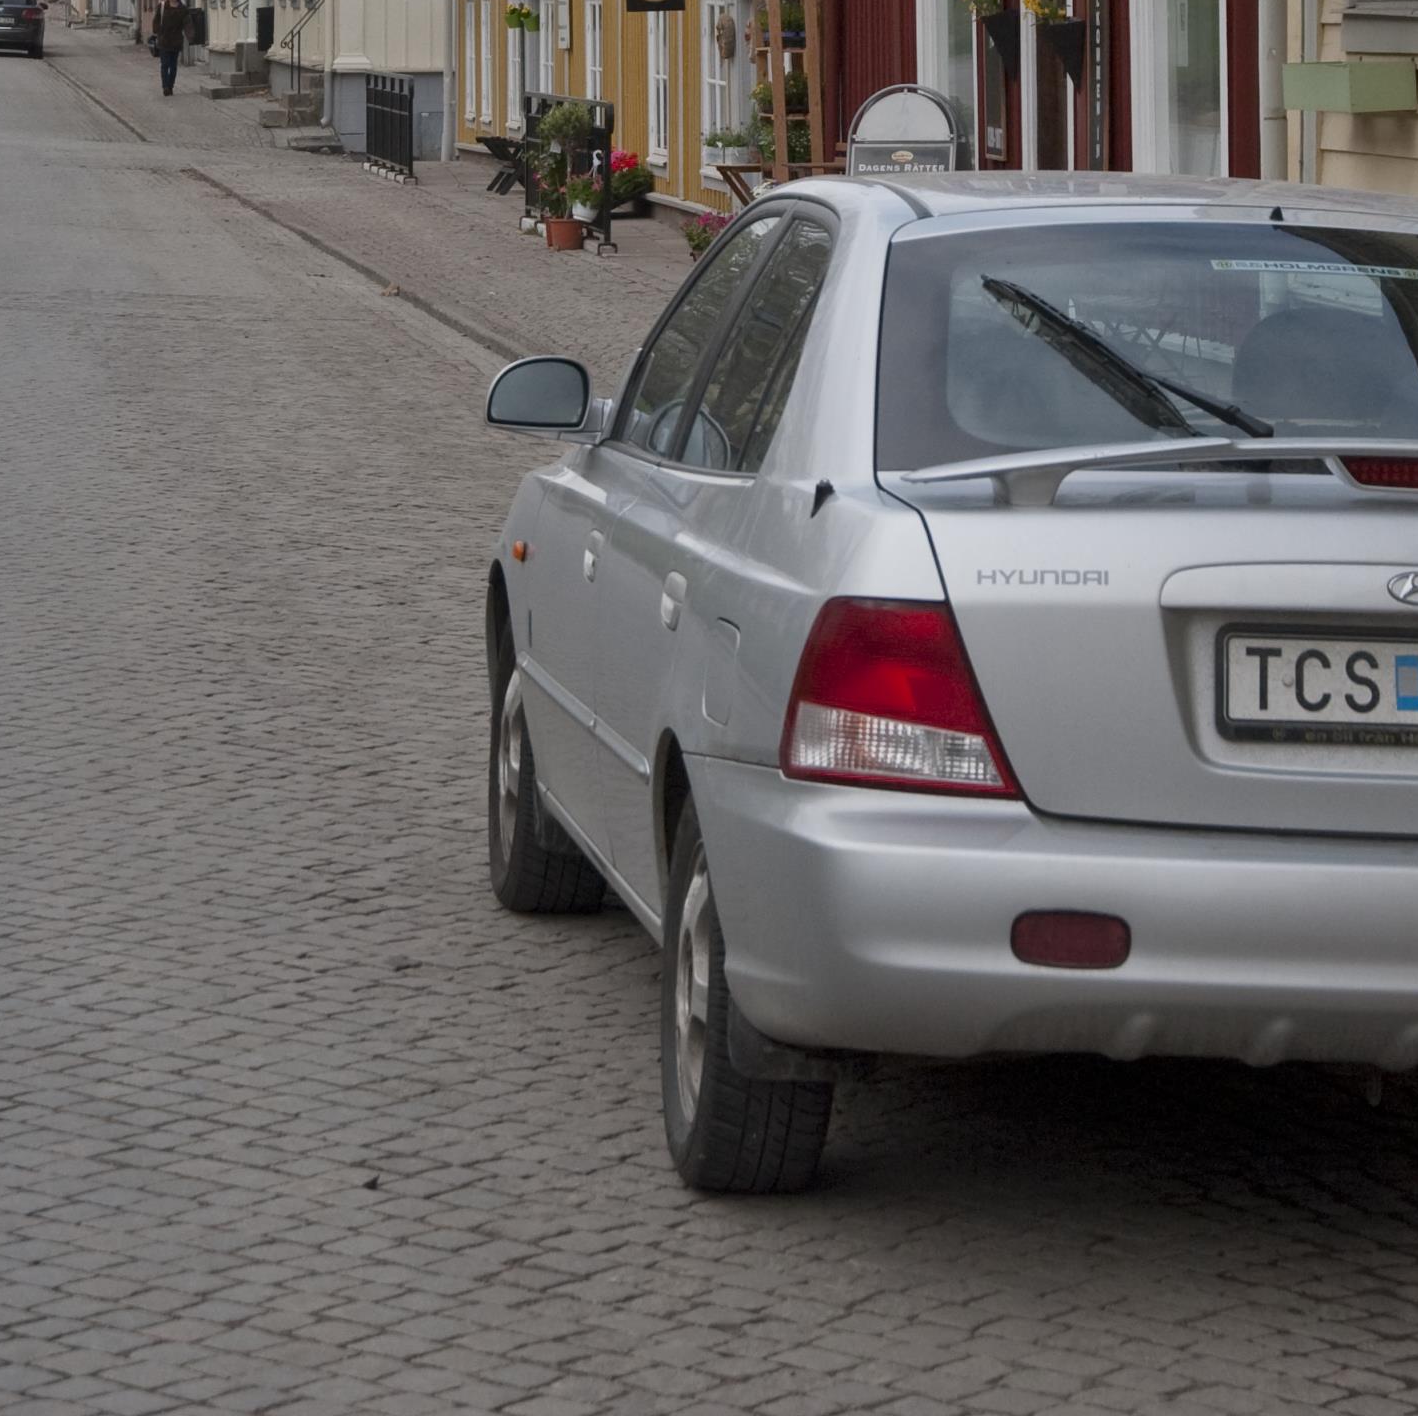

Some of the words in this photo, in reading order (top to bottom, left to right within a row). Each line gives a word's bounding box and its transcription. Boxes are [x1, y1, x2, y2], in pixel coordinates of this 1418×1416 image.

[858, 163, 901, 172] DAGENS
[904, 162, 946, 172] RÄTTER
[1263, 262, 1402, 276] HOLMGRENS
[976, 569, 1110, 586] HYUNDAI
[1245, 646, 1381, 713] TCS
